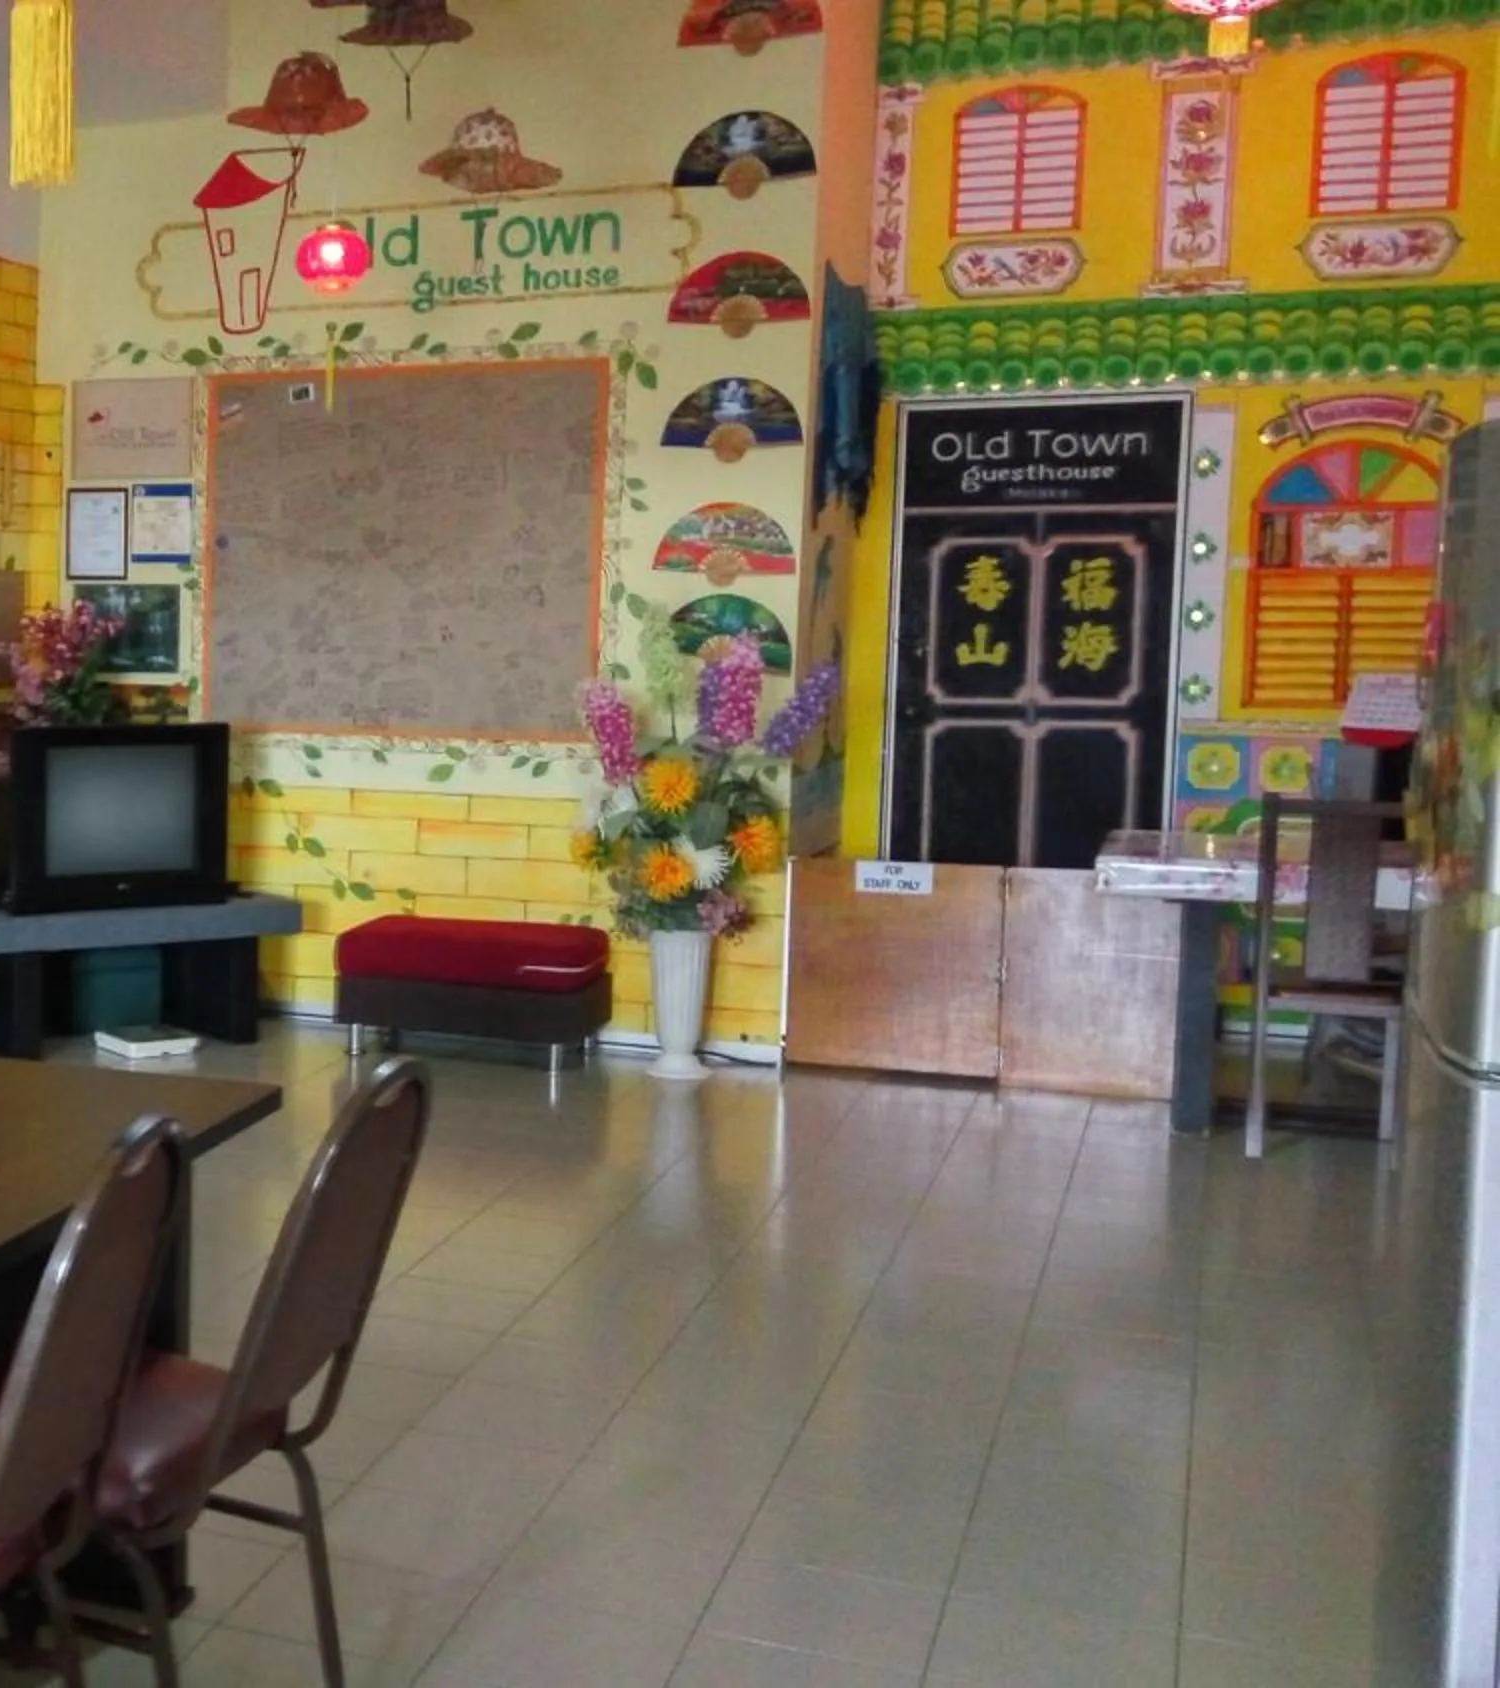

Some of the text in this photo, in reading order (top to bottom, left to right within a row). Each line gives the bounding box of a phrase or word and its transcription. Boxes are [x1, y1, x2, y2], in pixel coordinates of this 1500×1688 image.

[333, 207, 621, 270] ld Town
[412, 261, 621, 313] guest house
[1026, 429, 1148, 460] Town
[961, 463, 1116, 493] guesthouse
